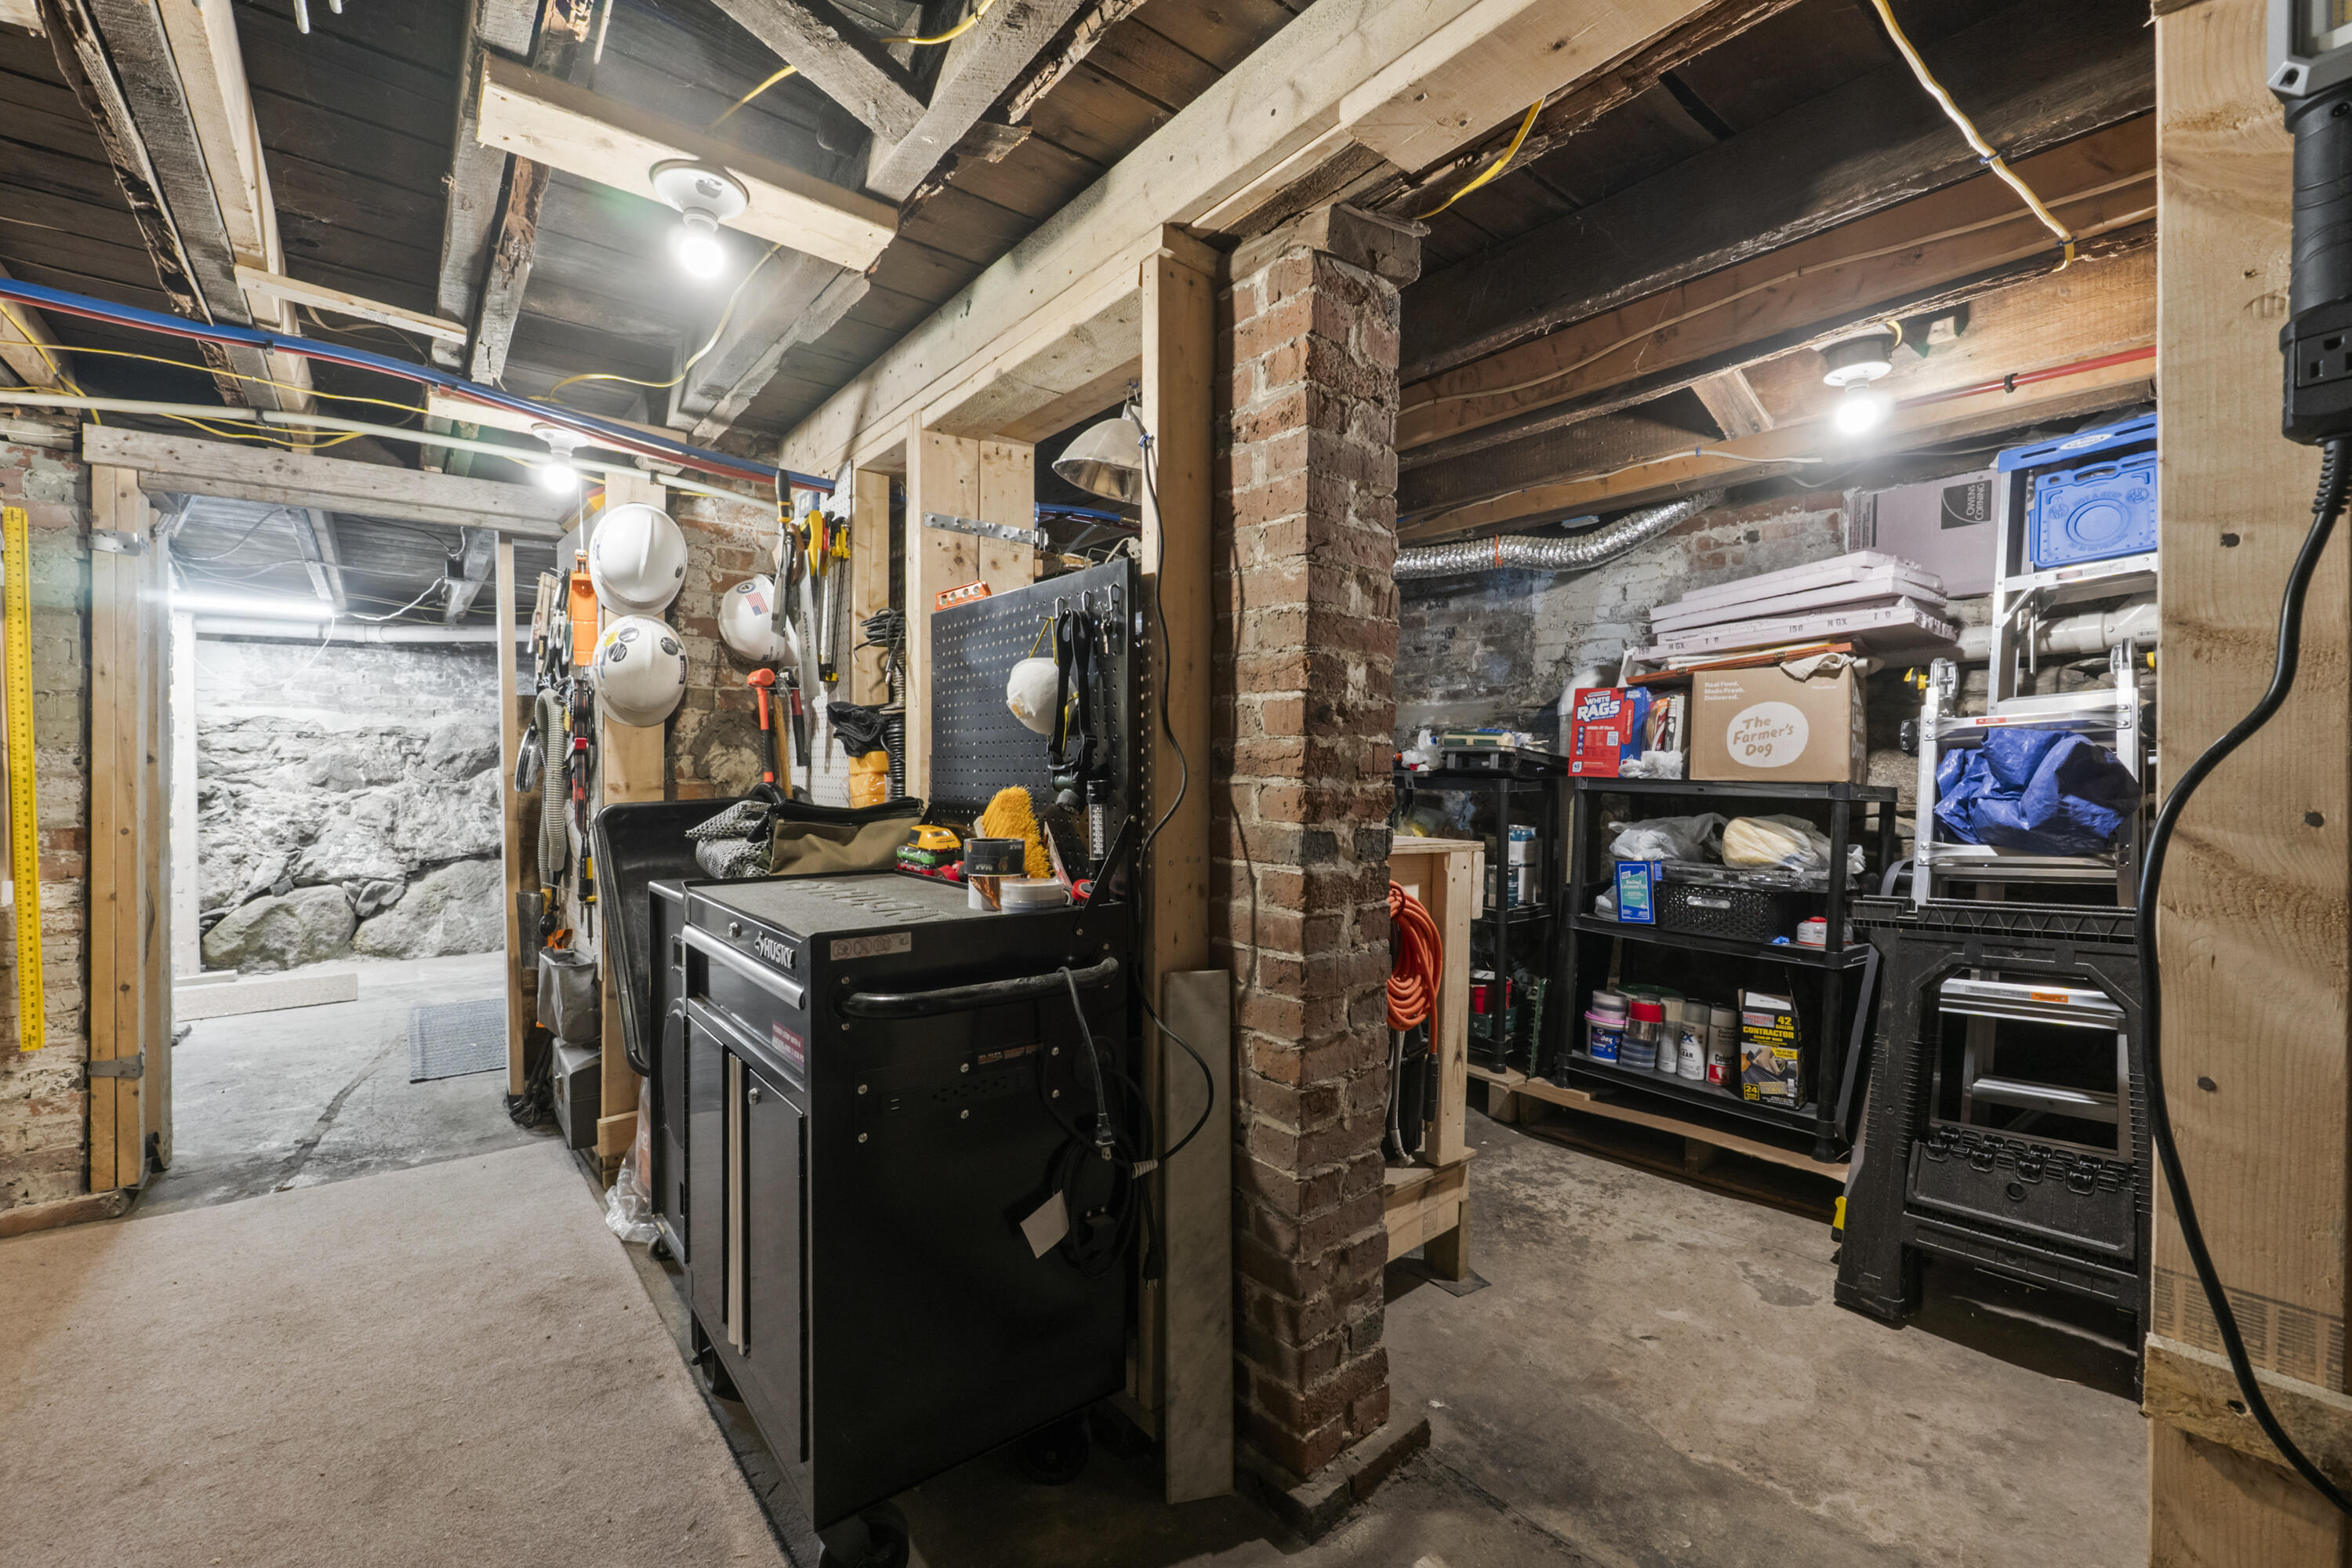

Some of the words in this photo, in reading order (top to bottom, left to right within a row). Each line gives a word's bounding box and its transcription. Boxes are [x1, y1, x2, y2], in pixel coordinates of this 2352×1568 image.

[1965, 485, 1976, 516] OWENS
[1975, 483, 1985, 521] CORNING
[1789, 625, 1803, 633] 150
[1584, 695, 1610, 706] WHITE
[1577, 700, 1621, 722] RAGS
[1742, 717, 1771, 729] The
[1733, 724, 1794, 745] Farmer's
[1745, 743, 1773, 757] Dog
[764, 938, 796, 969] HUSKY
[1777, 1015, 1792, 1025] 42
[1743, 1025, 1794, 1039] CONTRACTOR
